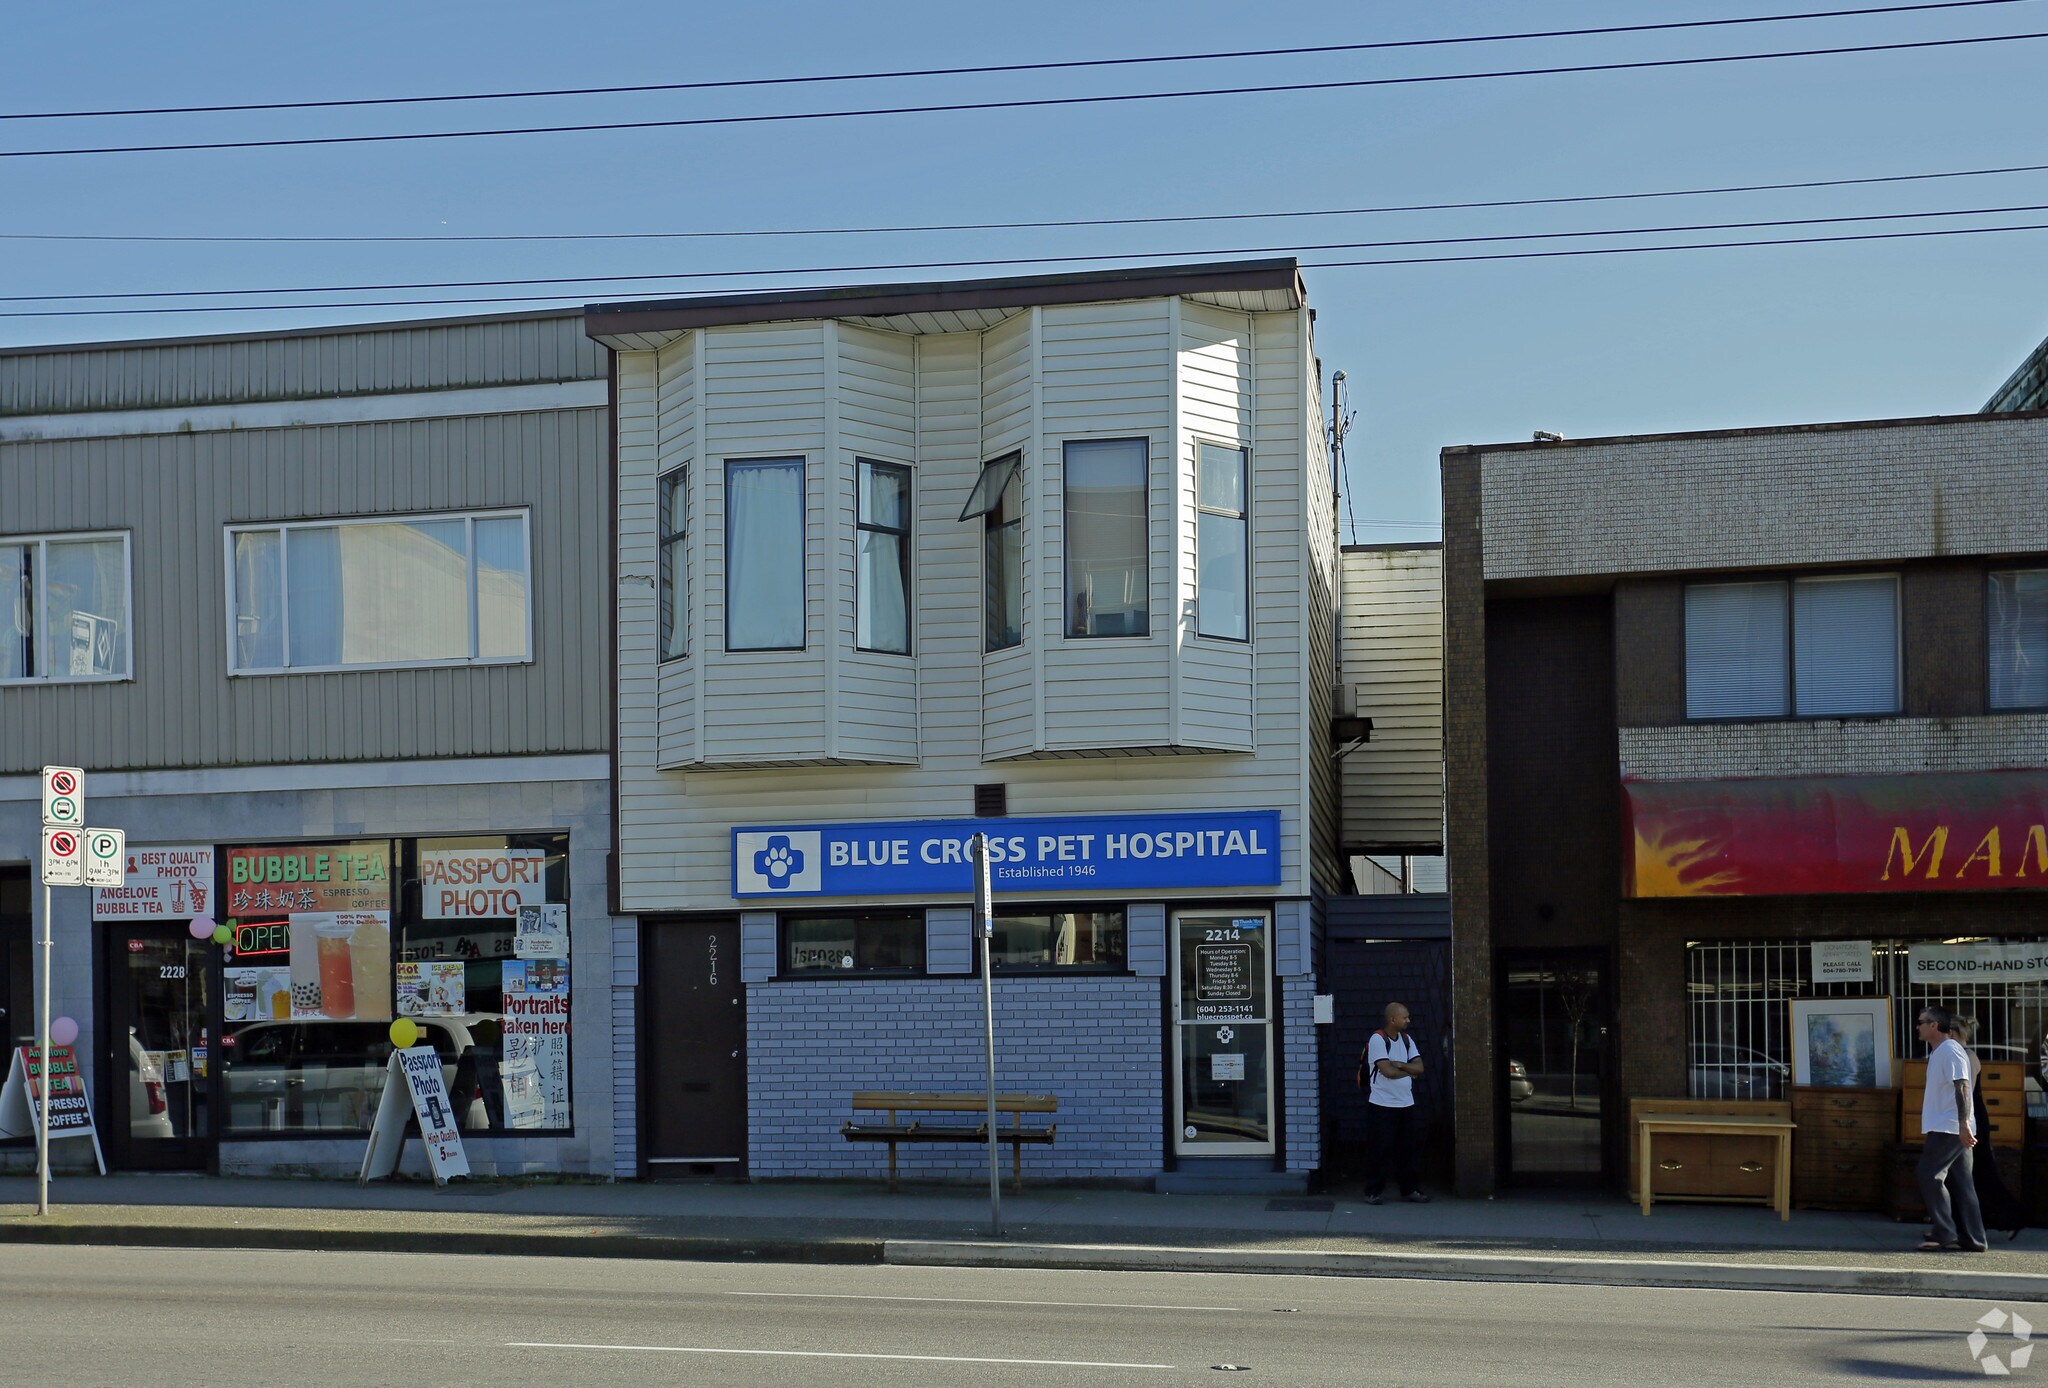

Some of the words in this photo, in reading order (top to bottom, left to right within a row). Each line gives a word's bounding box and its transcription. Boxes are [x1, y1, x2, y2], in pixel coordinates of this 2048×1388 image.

[830, 839, 909, 866] BLUE
[1038, 835, 1094, 861] PET
[1106, 829, 1267, 859] HOSPITAL
[48, 859, 60, 867] 3PM
[66, 860, 78, 868] 6PM
[142, 853, 166, 865] BEST
[169, 852, 211, 865] QUALITY
[107, 869, 120, 877] 3PM
[157, 866, 197, 877] PHOTO
[233, 854, 330, 884] BUBBLE
[336, 852, 387, 882] TEA
[422, 857, 544, 886] PASSPORT
[999, 865, 1064, 878] Established
[1069, 865, 1096, 876] 1946
[100, 887, 158, 899] ANGELOVE
[323, 888, 369, 897] ESPRESSO
[232, 888, 317, 912] 珍珠奶茶
[352, 900, 386, 908] COFFEE
[441, 888, 522, 916] PHOTO
[96, 902, 139, 914] BUBBLE
[142, 902, 163, 913] TEA
[1205, 929, 1241, 941] 2214
[709, 935, 718, 985] 2216
[1917, 960, 2024, 971] SECOND-HAND
[160, 966, 185, 978] 2228
[397, 963, 418, 974] Hot
[503, 993, 570, 1015] Portraits
[1196, 1005, 1216, 1013] (604)
[500, 1017, 539, 1035] taken
[542, 1017, 571, 1035] here
[29, 1061, 75, 1075] BBBLE
[400, 1053, 442, 1075] Passport
[412, 1075, 440, 1096] Photo
[35, 1097, 85, 1112] EPRESSO
[47, 1112, 84, 1127] COFFEE
[427, 1132, 440, 1147] High
[440, 1129, 458, 1143] Quality
[440, 1146, 447, 1161] 5
